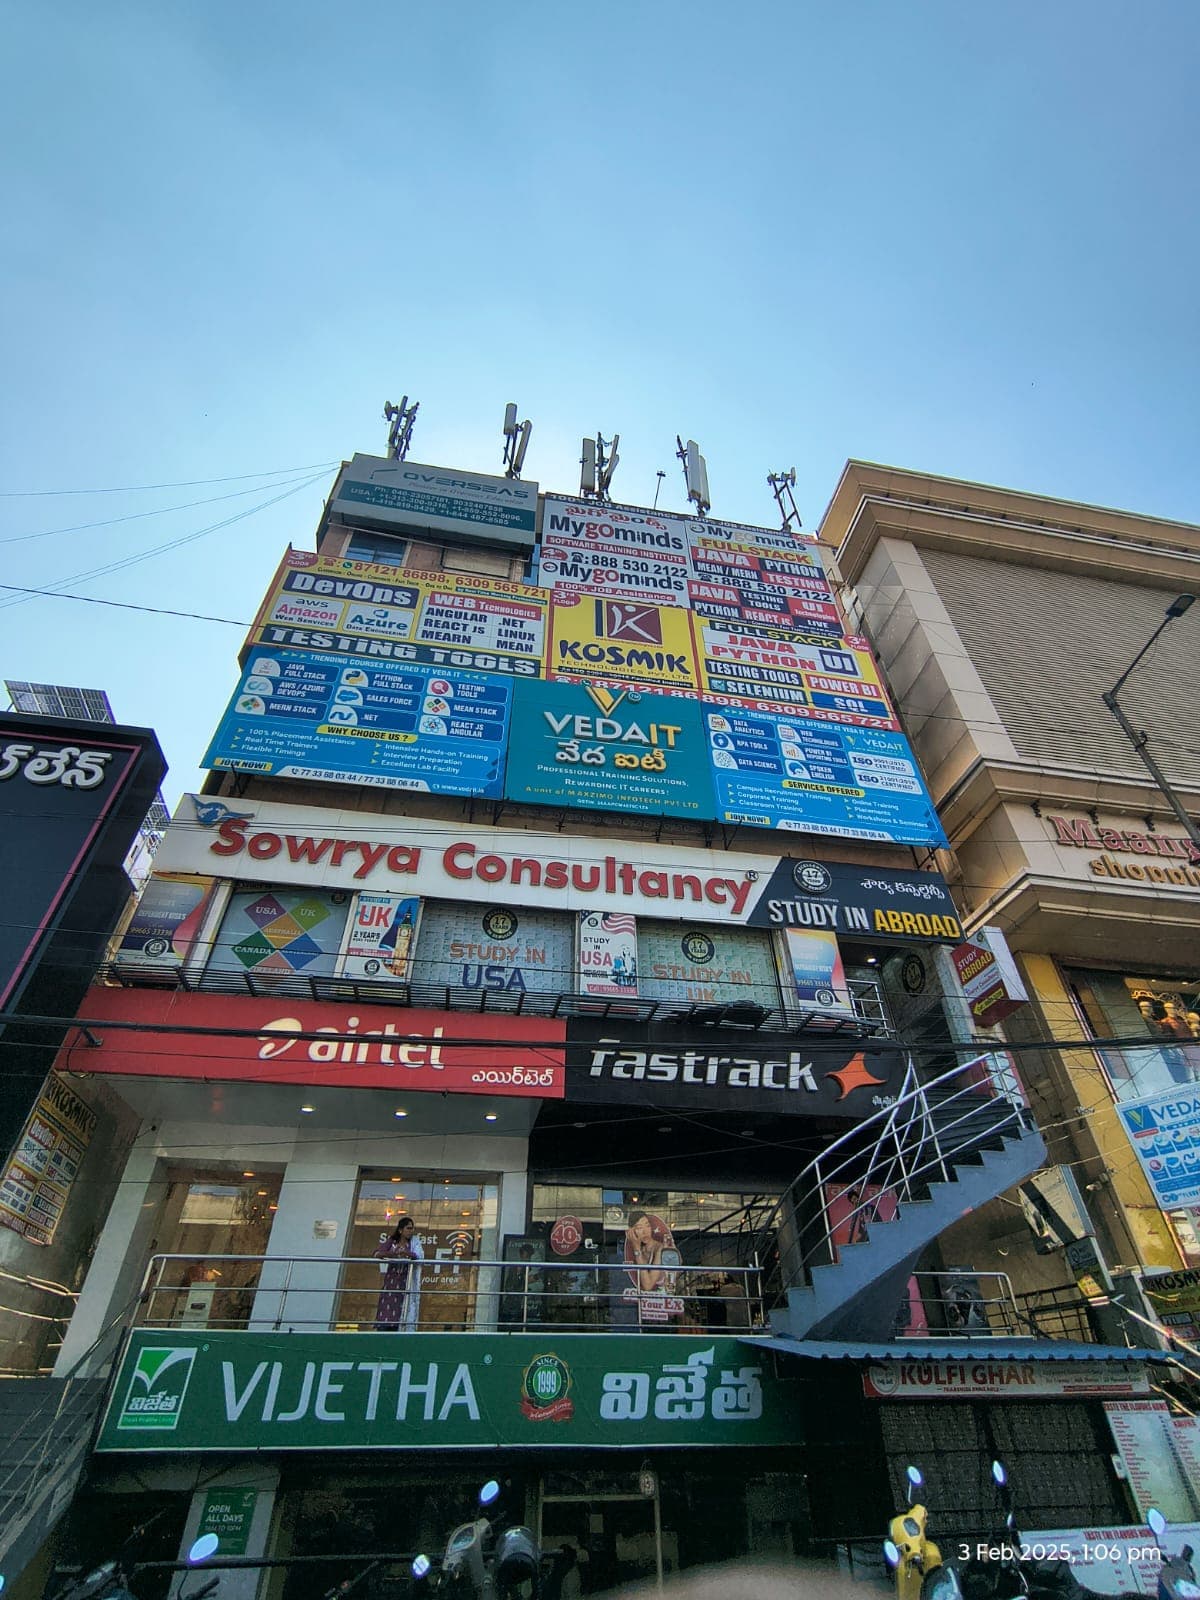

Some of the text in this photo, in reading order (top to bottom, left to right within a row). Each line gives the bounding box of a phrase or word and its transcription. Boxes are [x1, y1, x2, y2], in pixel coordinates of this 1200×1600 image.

[403, 472, 528, 499] OVERSEAS
[550, 537, 684, 562] SOFTWARE TRAINING INSTITUTE
[591, 555, 688, 578] 888 530 2122
[697, 550, 819, 578] JAVA PYTHON
[292, 573, 412, 605] DevOps
[354, 563, 398, 576] 87121
[402, 570, 450, 583] 86898,
[455, 577, 490, 589] 6309
[493, 582, 518, 593] 565
[523, 587, 546, 598] 721
[722, 577, 832, 602] 888 530 2122
[766, 573, 825, 591] TESTING
[296, 598, 329, 608] aws
[434, 594, 475, 608] WEB
[616, 590, 673, 600] Assistance
[691, 585, 737, 601] JAVA
[277, 604, 338, 621] Amazon
[695, 602, 778, 623] PYTHON REACT
[750, 601, 780, 611] TOOLS
[350, 614, 408, 630] Azure
[426, 608, 526, 628] ANGULAR .NET
[424, 619, 536, 642] REACT JS LINUX
[270, 626, 535, 674] TESTING TOOLS
[421, 630, 533, 653] MEARN MEAN
[727, 635, 796, 654] JAVA
[560, 640, 690, 674] KOSMIK
[560, 659, 645, 675] TECHNOLOGIES
[711, 646, 816, 670] PYTHON
[822, 654, 855, 671] UI
[708, 661, 877, 697] TESTING TOOLS POWER BI
[727, 681, 804, 702] SELENIUM
[757, 702, 810, 717] 6309
[814, 710, 853, 724] 565
[859, 716, 893, 730] 721
[271, 731, 312, 741] Placement
[314, 735, 356, 745] Assistance
[327, 726, 348, 735] WHY
[350, 729, 386, 739] CHOOSE
[544, 712, 682, 747] VEDAIT
[555, 738, 606, 765] వేద
[852, 756, 874, 765] ISO
[787, 780, 860, 797] SERVICES OFFERED
[857, 774, 879, 784] ISO
[210, 818, 752, 915] Sowrya Consultancy
[255, 906, 316, 917] USA UK
[358, 905, 392, 928] UK
[494, 916, 505, 925] 17
[768, 900, 961, 939] STUDY IN ABROAD
[234, 945, 272, 954] CANADA
[582, 936, 610, 945] STUDY
[692, 940, 703, 948] 17
[450, 942, 546, 964] STUDY IN
[581, 950, 613, 967] USA
[957, 950, 977, 970] STUDY
[653, 964, 722, 982] STUDY
[960, 951, 993, 983] ABROAD
[462, 964, 527, 993] USA
[307, 1016, 446, 1070] airtel
[641, 1300, 663, 1310] Your
[537, 1371, 556, 1393] 1999
[600, 1346, 763, 1420] విజేత
[901, 1363, 965, 1385] KULFI
[972, 1363, 1037, 1385] GHAR
[222, 1360, 481, 1422] VIJETHA
[205, 1514, 244, 1522] ALL DAYS
[208, 1505, 231, 1513] OPEN
